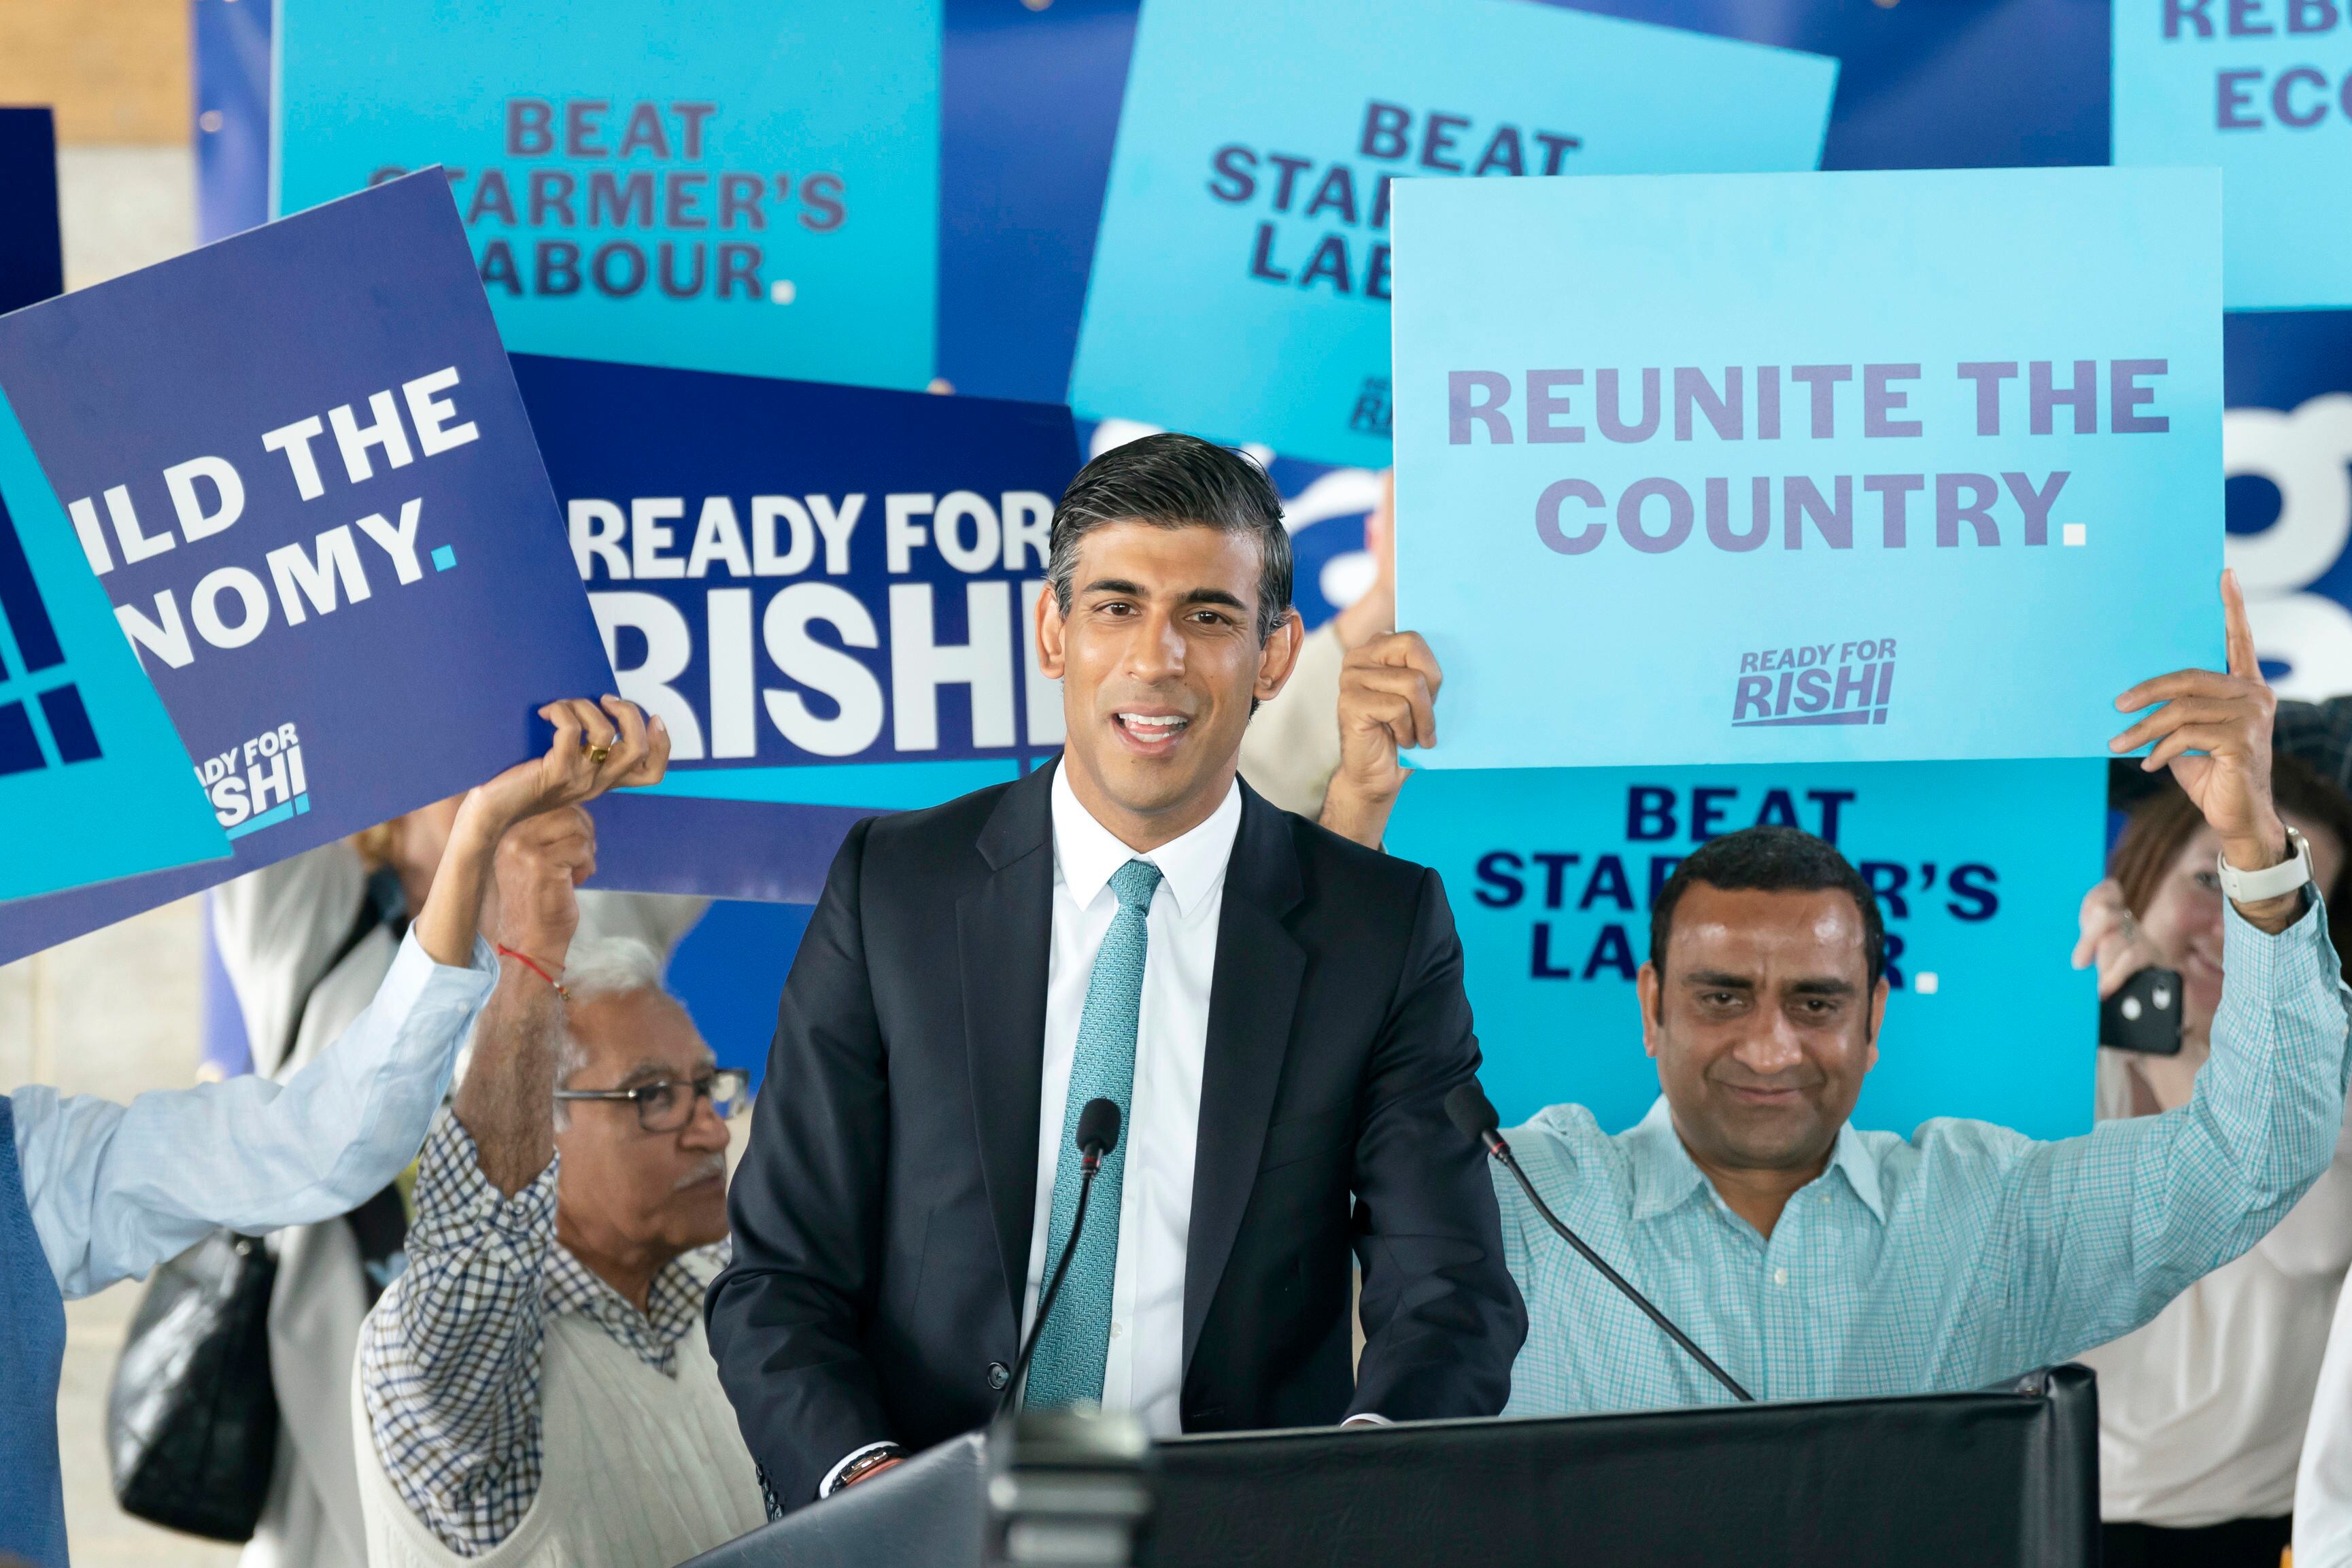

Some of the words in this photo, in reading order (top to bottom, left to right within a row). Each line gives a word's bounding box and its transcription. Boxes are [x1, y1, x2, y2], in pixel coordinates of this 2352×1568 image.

[2164, 0, 2352, 39] REB
[507, 99, 716, 159] BEAT
[2217, 69, 2352, 129] EC
[1357, 99, 1581, 177] BEAT
[369, 166, 847, 233] ARMER’S
[1448, 362, 1922, 445] REUNITE
[1957, 359, 2170, 437] THE
[262, 366, 480, 503] THE
[566, 493, 867, 581] READY
[885, 490, 1056, 573] FOR
[1535, 473, 2086, 554] COUNTRY.
[1740, 643, 1835, 674] READY
[1839, 638, 1896, 663] FOR
[243, 722, 299, 766] FOR
[1626, 785, 1856, 842] BEAT
